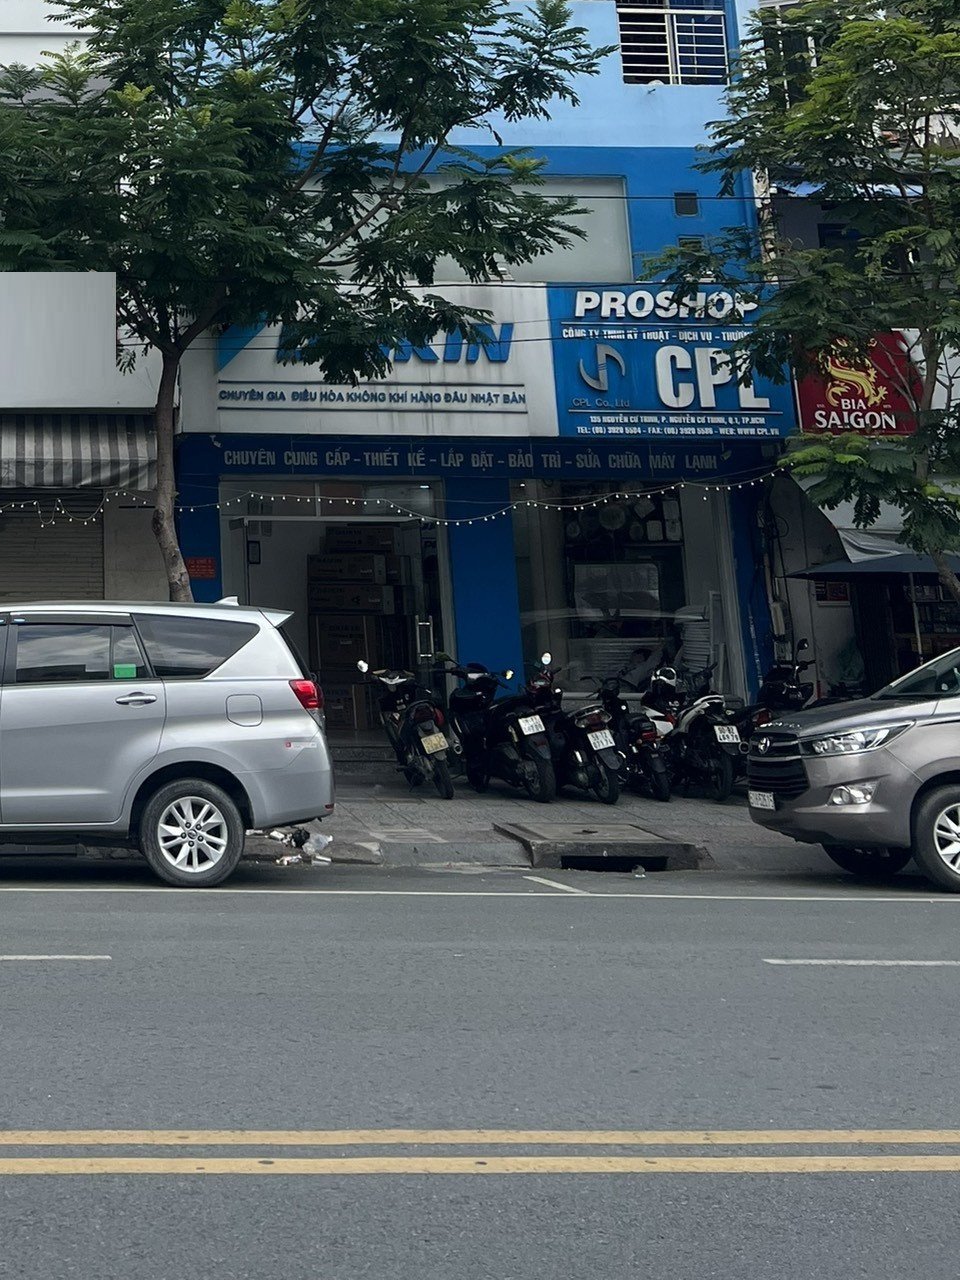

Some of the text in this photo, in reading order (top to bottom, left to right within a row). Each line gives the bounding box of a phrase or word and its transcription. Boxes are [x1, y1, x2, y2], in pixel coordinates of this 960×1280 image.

[575, 290, 759, 319] PROSHOP
[562, 327, 586, 339] CÔNG
[679, 331, 698, 343] DỊCH
[700, 331, 712, 343] VỤ
[655, 345, 771, 408] CPL
[219, 388, 263, 402] CHUYÊN
[266, 391, 286, 402] GIA
[346, 389, 386, 403] KHÔNG
[390, 390, 407, 403] KHÍ
[471, 391, 500, 406] NHẬT
[502, 391, 526, 404] BẢN
[840, 398, 867, 410] BIA
[814, 410, 897, 429] SAIGON
[224, 448, 276, 466] CHUYÊN
[284, 451, 318, 466] CUNG
[325, 447, 350, 466] CẤP
[364, 447, 399, 466] THIẾT
[408, 447, 426, 467] KẾ
[441, 447, 463, 467] LẮP
[471, 450, 494, 471] ĐẶT
[508, 448, 533, 468] BẢO
[542, 449, 561, 468] TRÌ
[576, 448, 601, 468] SỬA
[608, 450, 641, 469] CHỮA
[649, 450, 675, 469] MÁY
[685, 453, 717, 472] LẠNH
